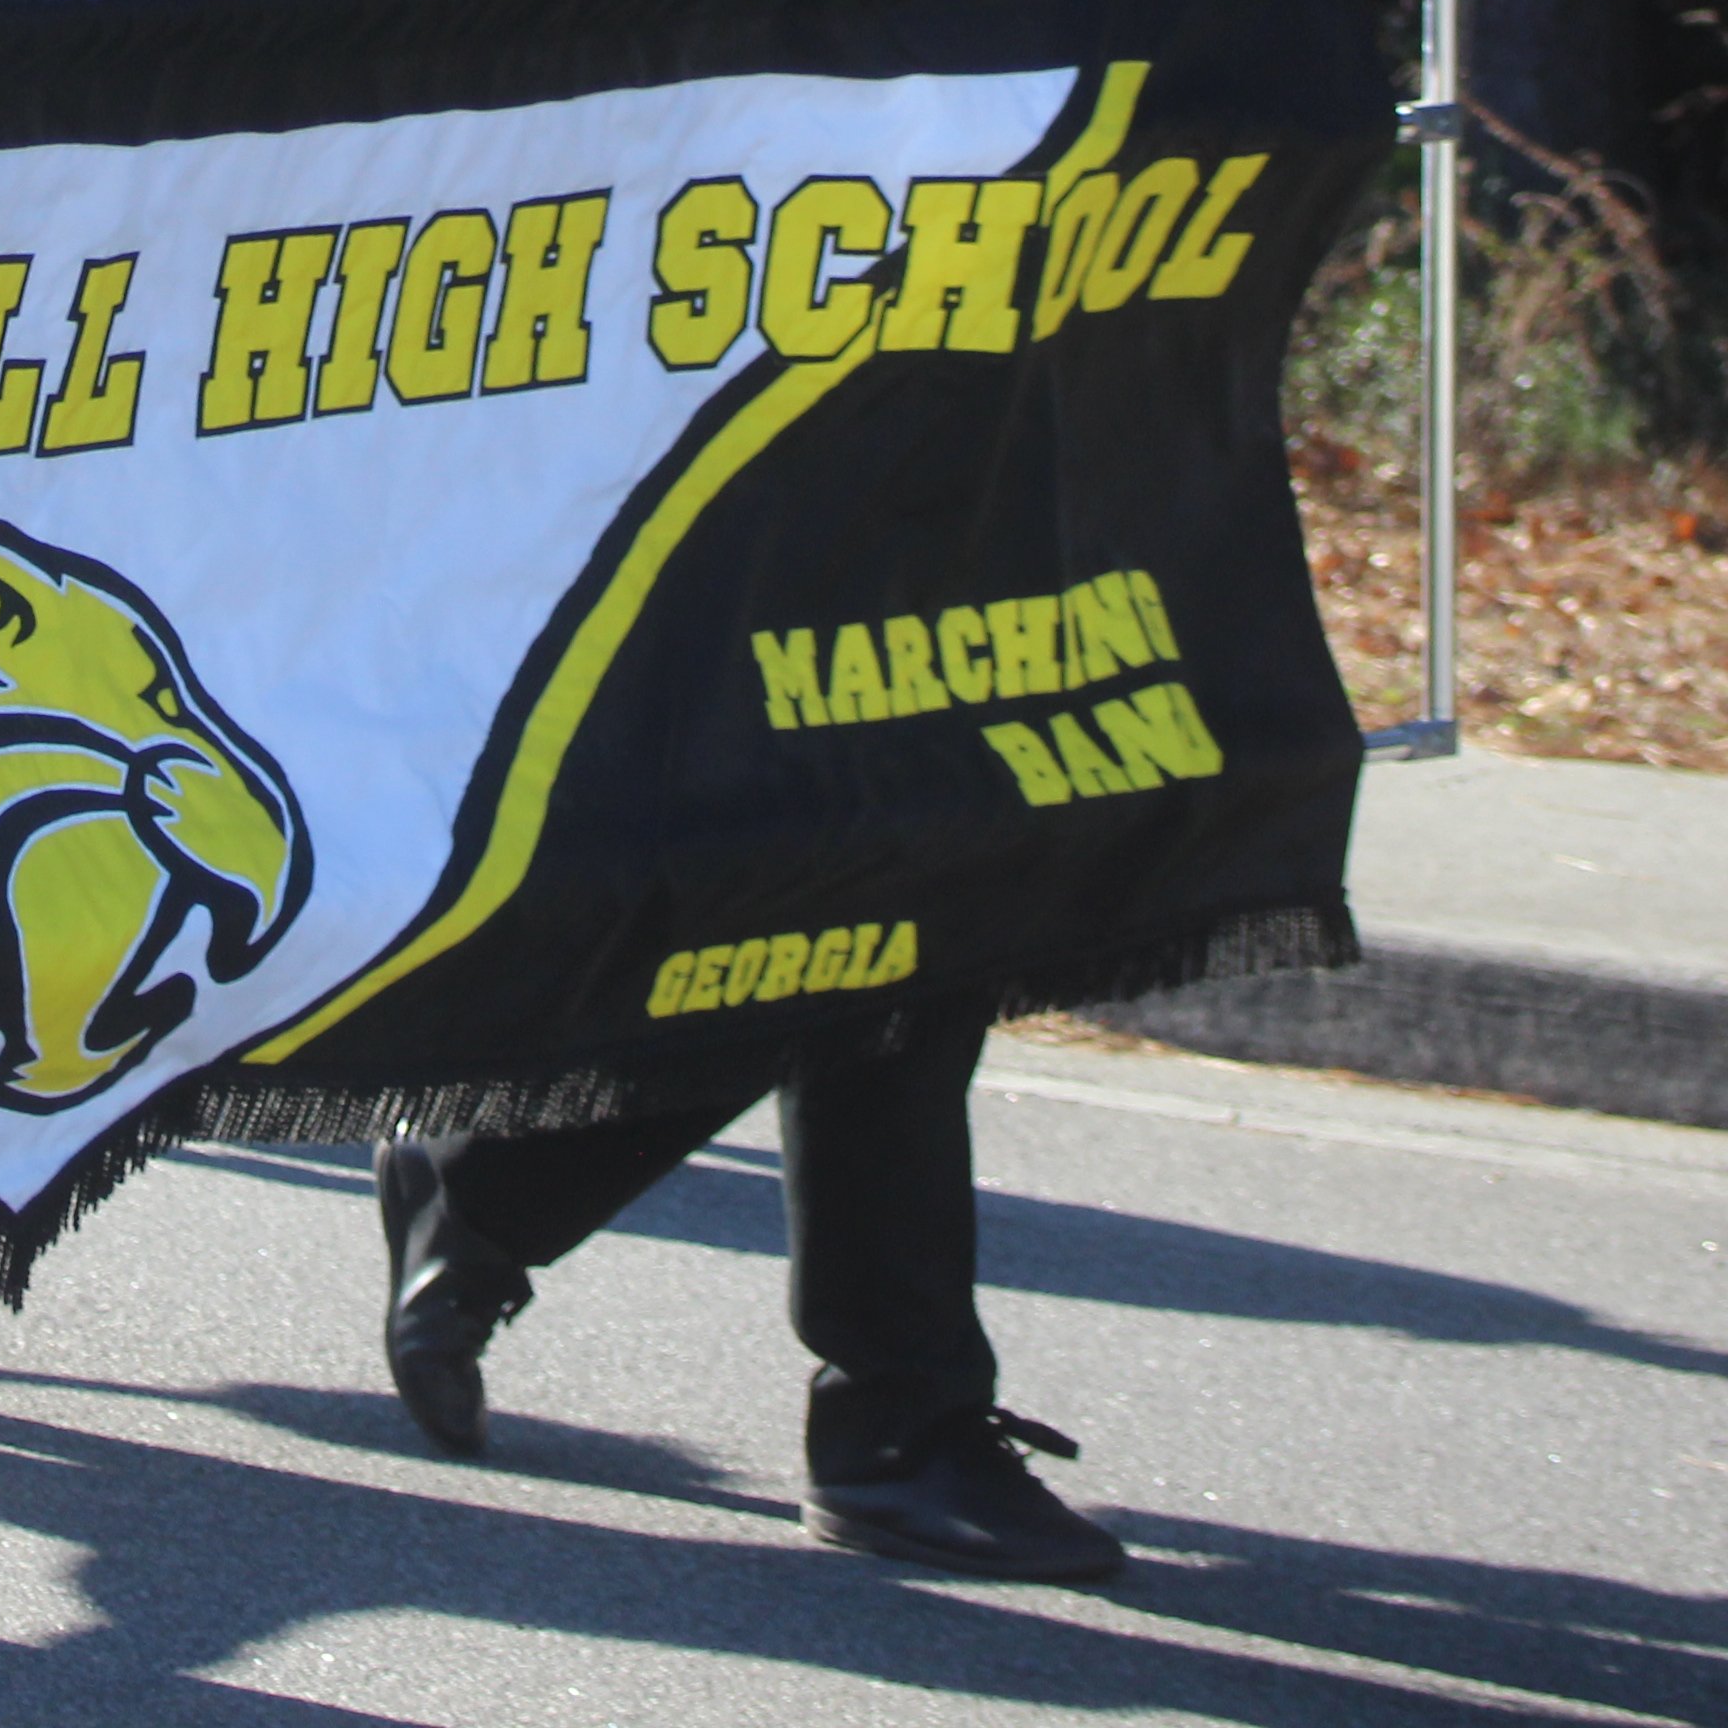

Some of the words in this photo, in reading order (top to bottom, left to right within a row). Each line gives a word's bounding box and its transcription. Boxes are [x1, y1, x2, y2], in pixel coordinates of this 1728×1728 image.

[196, 186, 613, 438] HIGH
[647, 153, 1270, 372] SCHOOL
[752, 569, 1181, 730] MARCHING
[982, 682, 1225, 807] BAND
[647, 920, 918, 1019] GEORGIA
